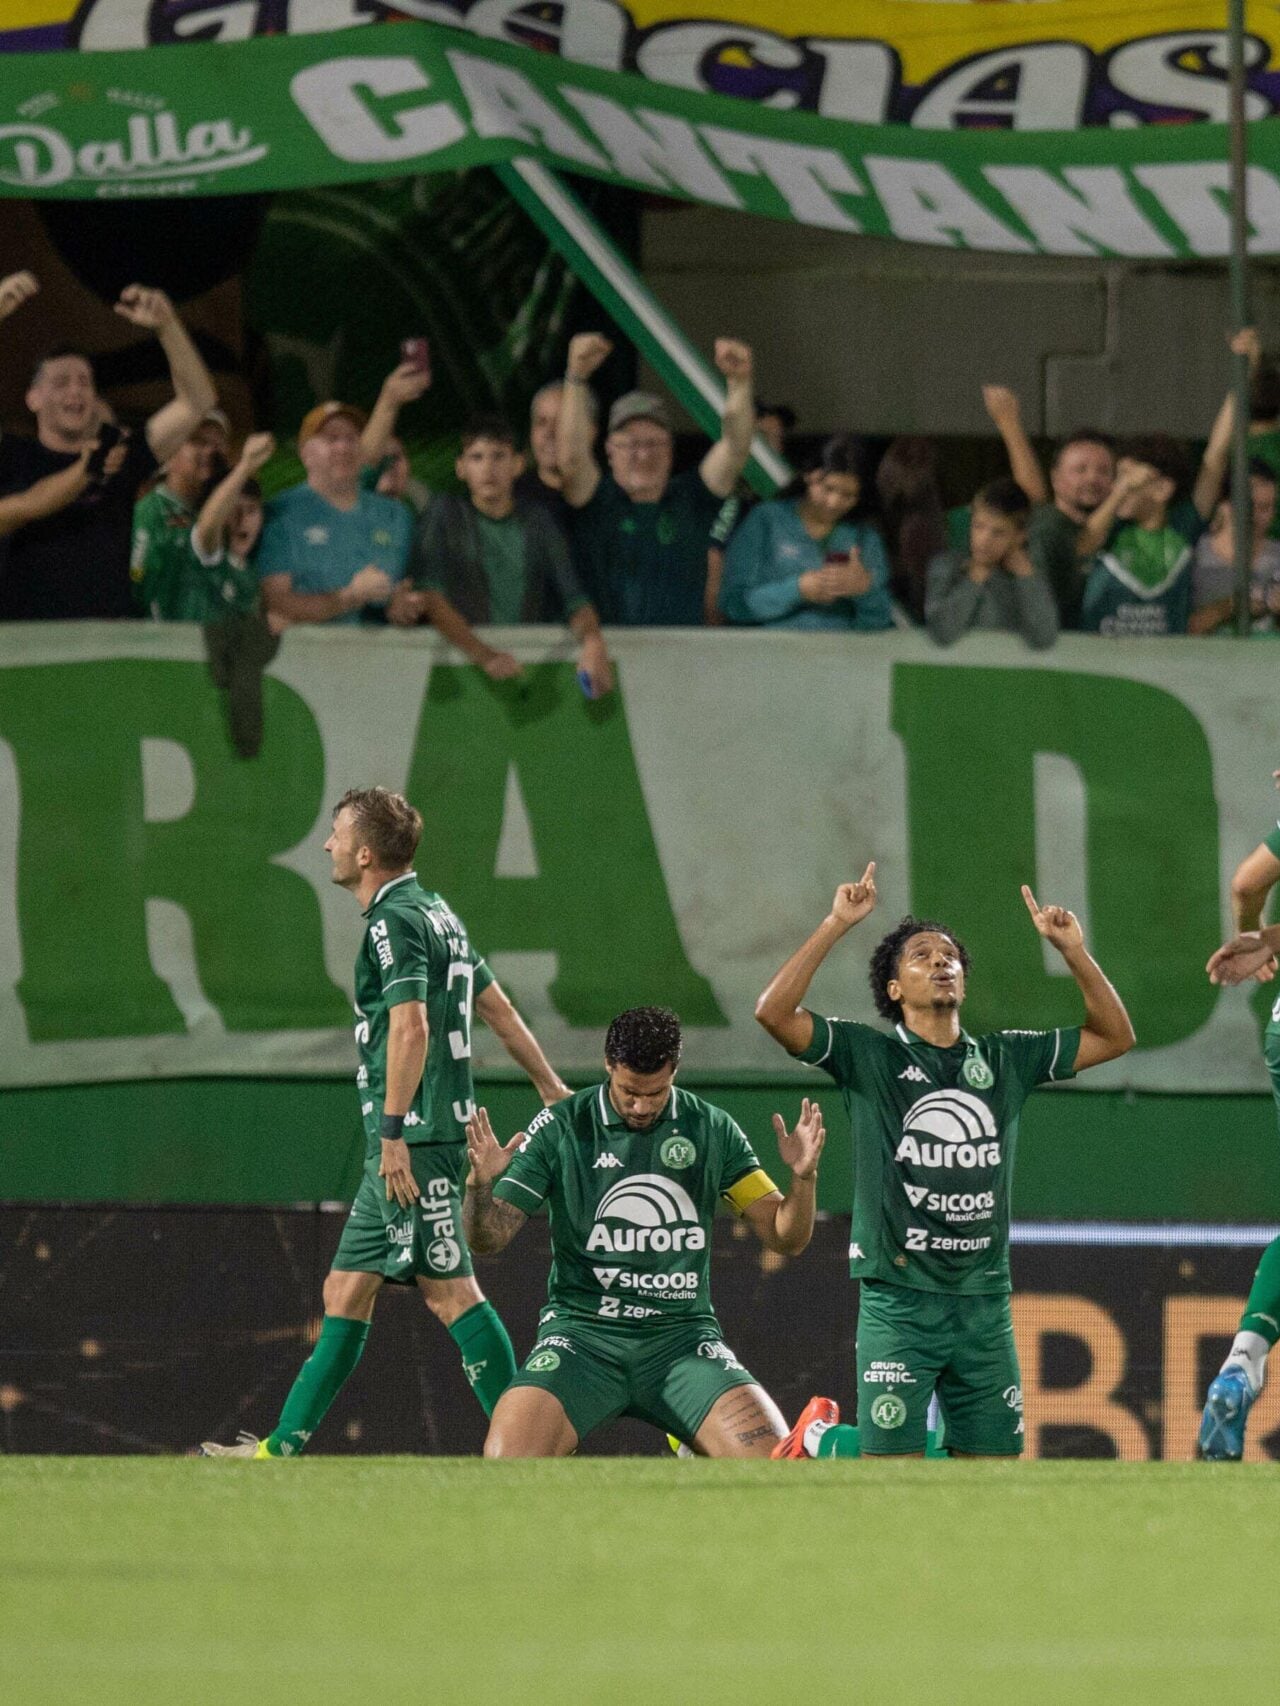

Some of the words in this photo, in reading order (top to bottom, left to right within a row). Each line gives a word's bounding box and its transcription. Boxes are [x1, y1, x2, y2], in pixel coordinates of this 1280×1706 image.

[0, 110, 266, 188] Dalla
[895, 1136, 1000, 1168] Aurora
[419, 1177, 455, 1238] alfa
[927, 1190, 995, 1212] SICOOB
[586, 1224, 706, 1252] Aurora
[930, 1236, 991, 1251] zeroum
[619, 1271, 699, 1289] SICOOB
[870, 1361, 905, 1371] GRUPO
